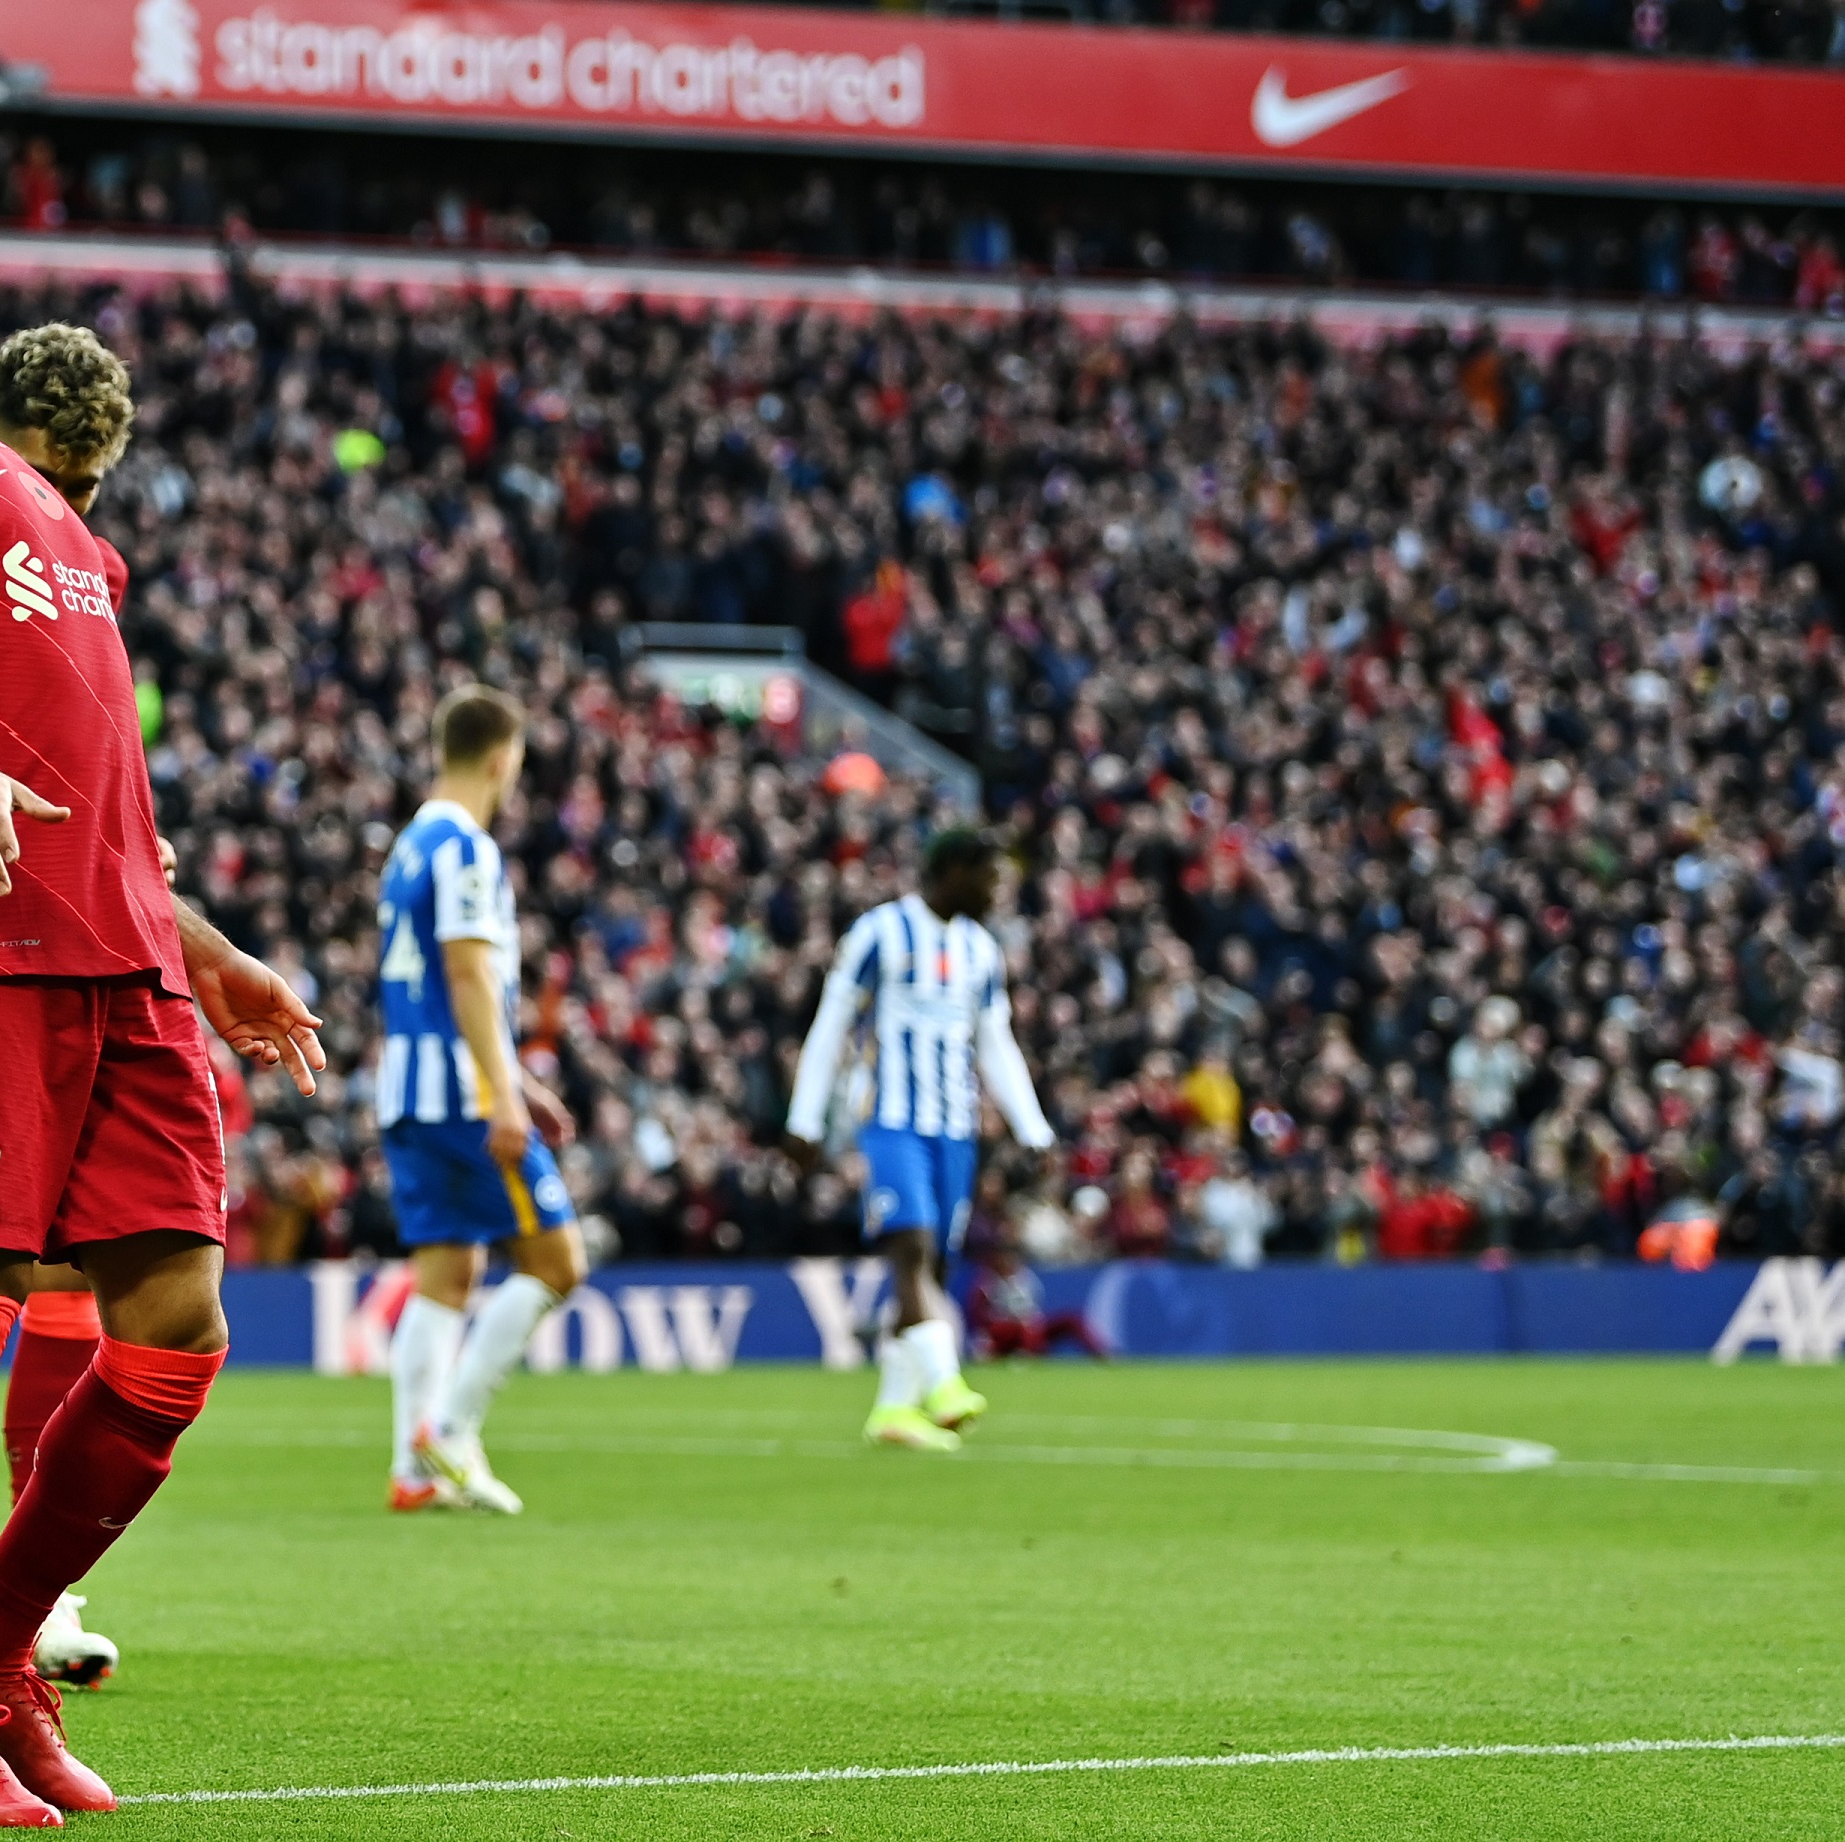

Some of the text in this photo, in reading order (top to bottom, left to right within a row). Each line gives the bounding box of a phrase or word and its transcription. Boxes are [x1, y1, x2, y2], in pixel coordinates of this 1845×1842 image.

[215, 8, 924, 127] standard chartered
[1709, 1254, 1845, 1368] AX
